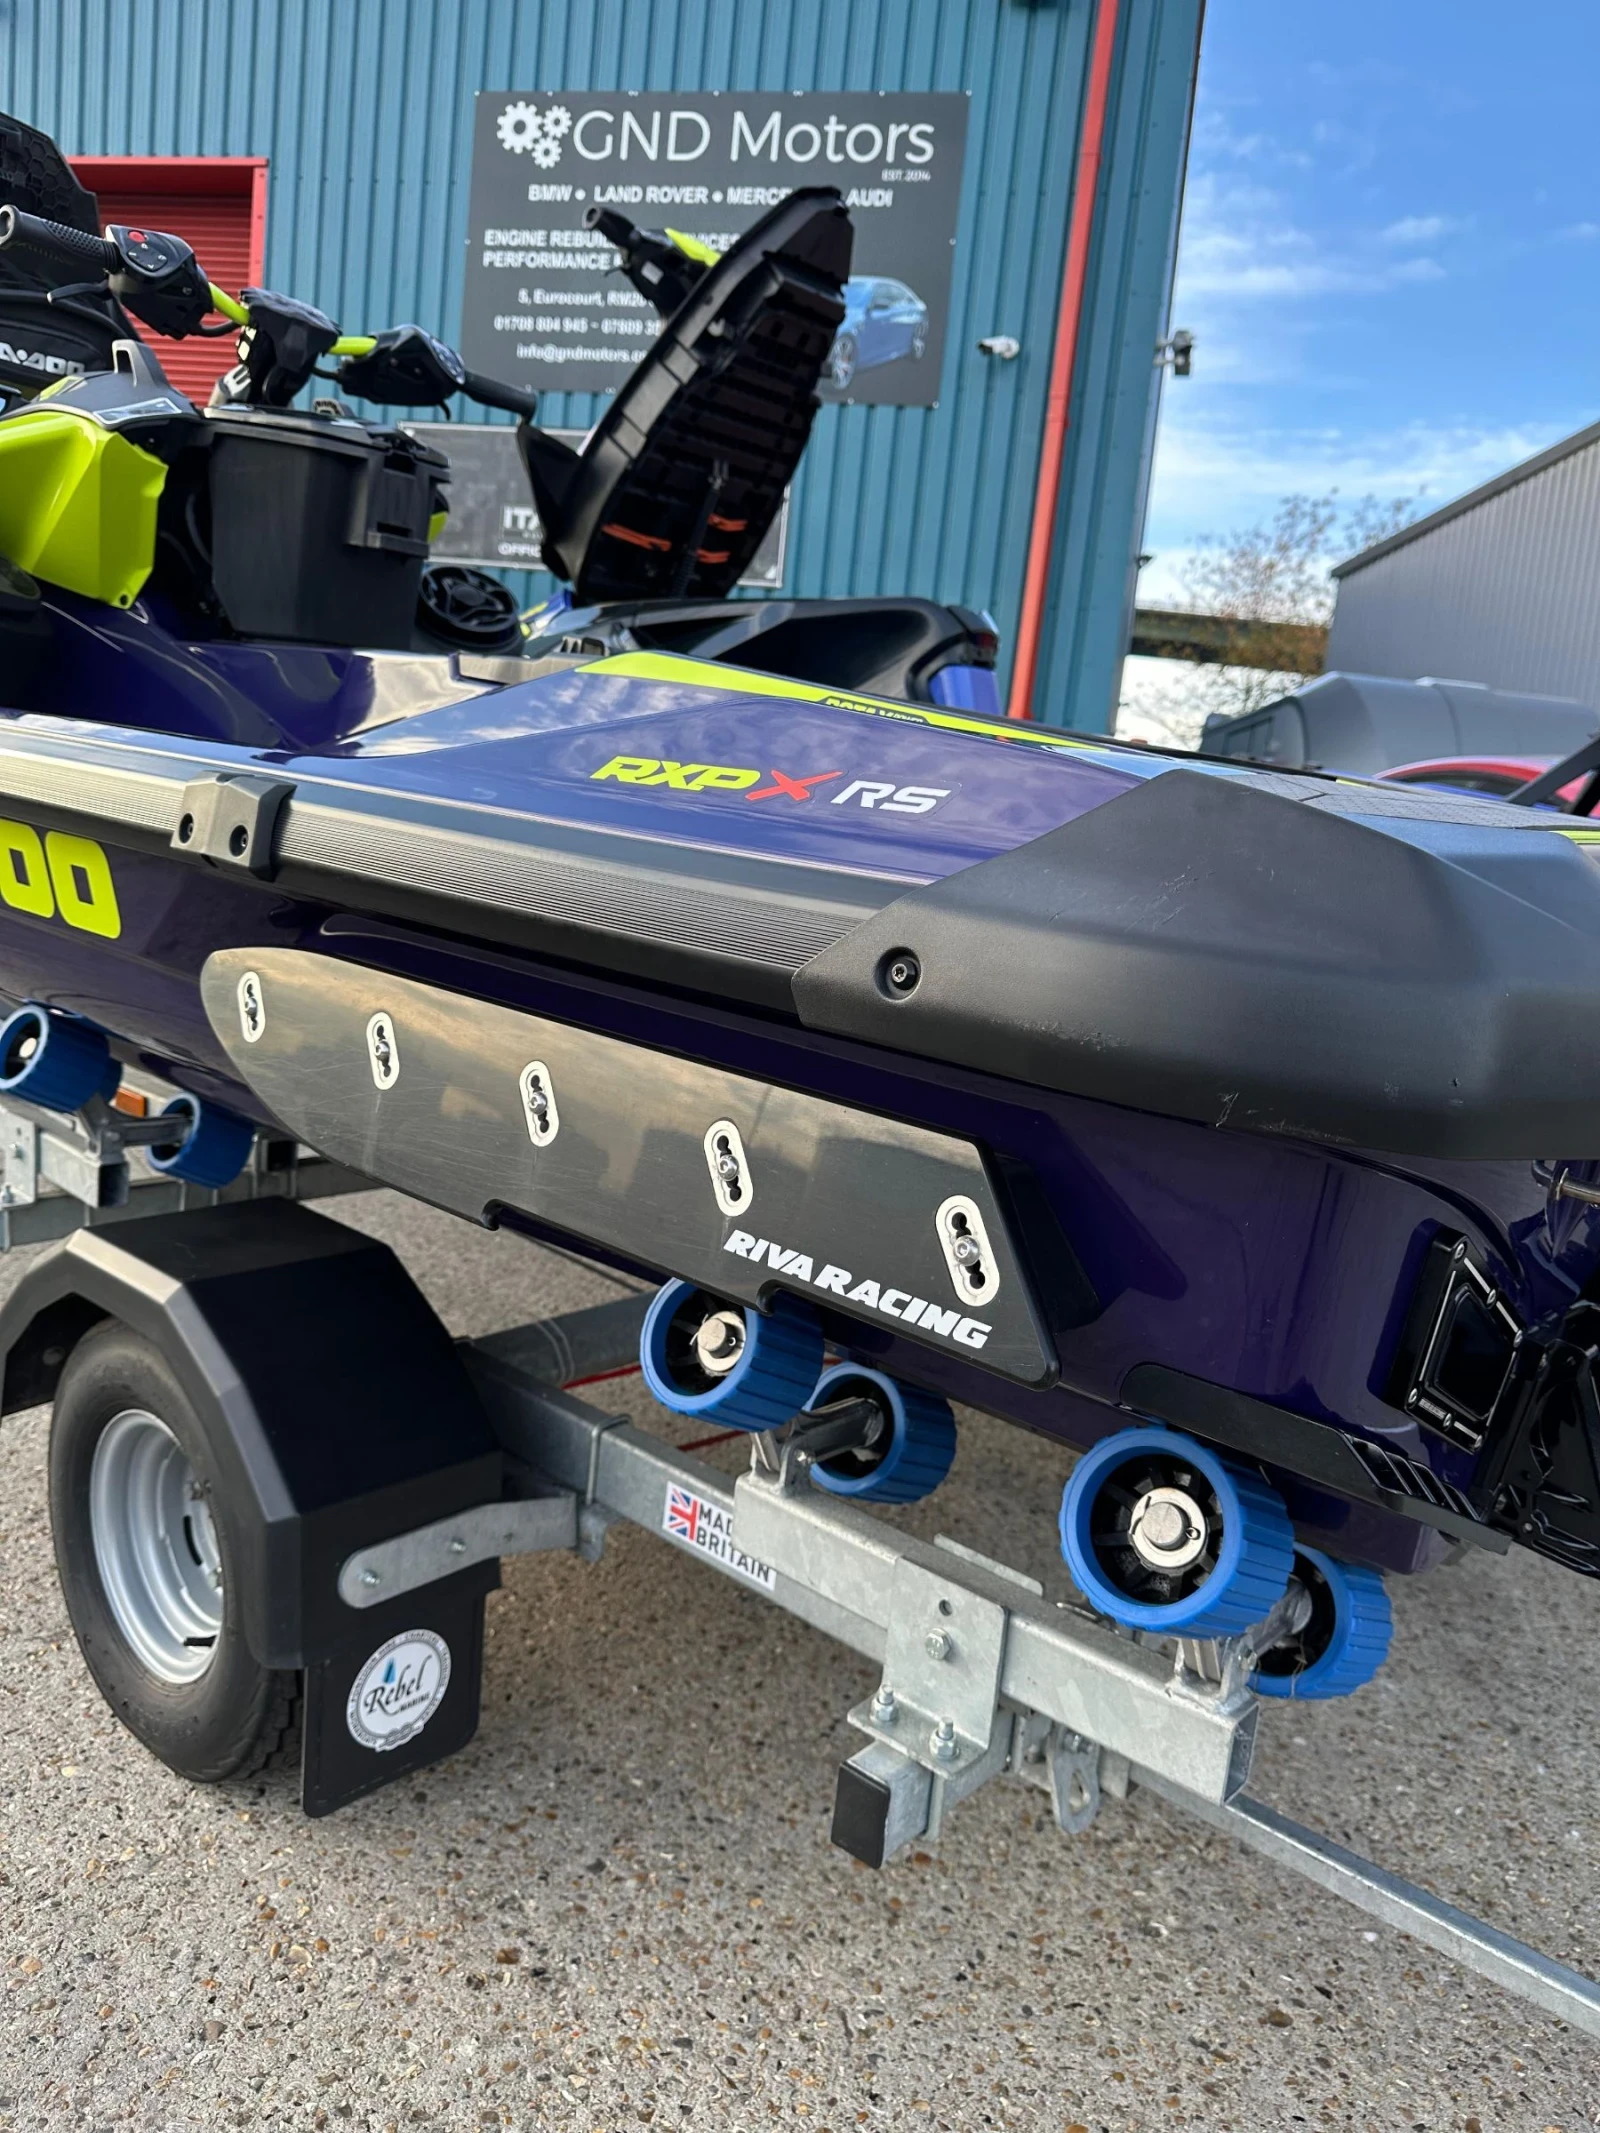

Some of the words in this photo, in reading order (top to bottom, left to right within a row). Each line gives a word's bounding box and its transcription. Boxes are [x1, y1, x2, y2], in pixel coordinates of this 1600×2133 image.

[572, 110, 711, 162] GND
[730, 111, 935, 164] Motors
[528, 184, 573, 202] BMW
[594, 184, 644, 203] LAND
[645, 185, 709, 204] ROVER
[845, 187, 894, 208] AUDI
[484, 229, 547, 247] ENGINE
[482, 250, 611, 270] PERFORMANCE
[830, 780, 952, 814] RS
[696, 1525, 771, 1583] BRITAIN
[363, 1654, 433, 1716] Rebel
